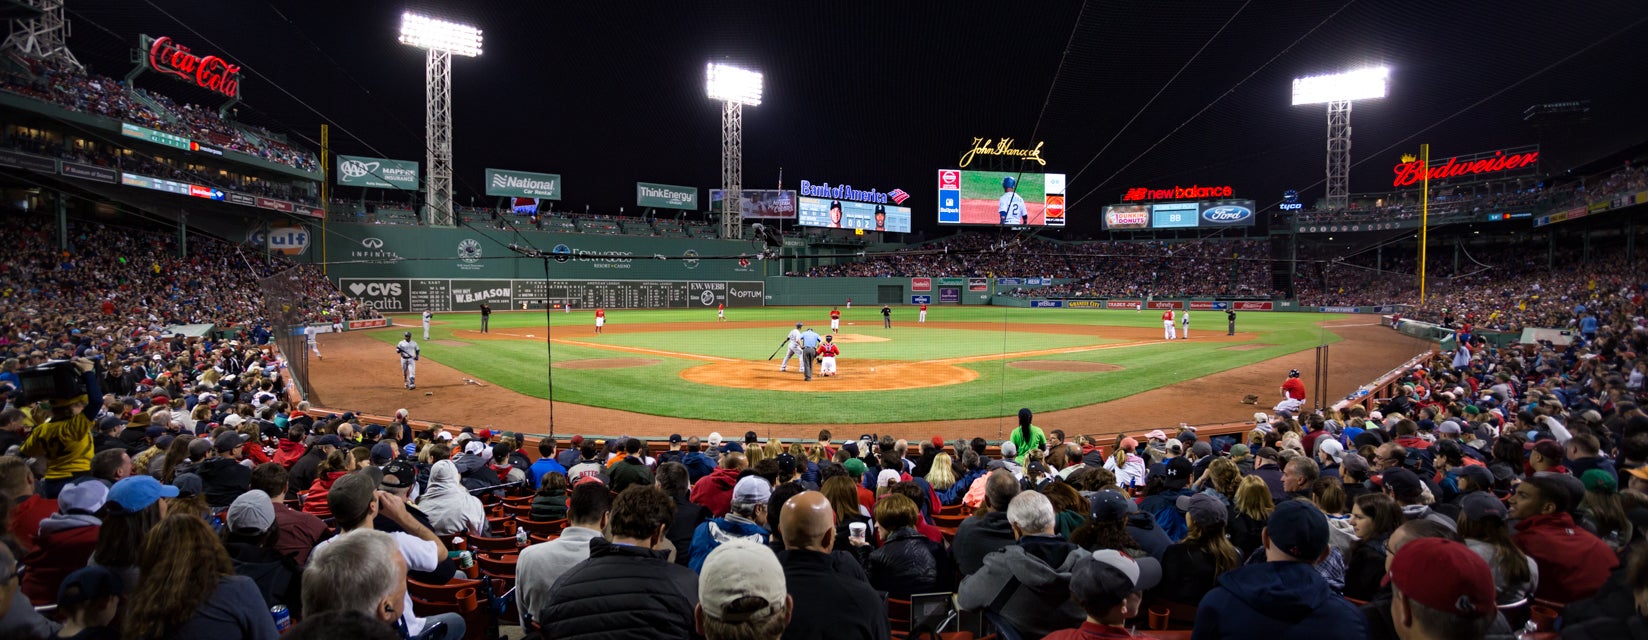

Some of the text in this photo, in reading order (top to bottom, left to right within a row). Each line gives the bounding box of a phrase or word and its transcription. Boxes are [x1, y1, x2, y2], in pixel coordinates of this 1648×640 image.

[150, 36, 240, 97] Coca-Cola
[959, 137, 1047, 168] John Hancock
[343, 160, 368, 177] AAA
[1393, 150, 1539, 187] Budweiser
[507, 176, 554, 190] National
[640, 186, 693, 202] ThinkEnergy
[800, 179, 888, 204] Bank of America
[1148, 190, 1175, 199] new
[1175, 185, 1233, 199] balance
[1012, 204, 1019, 216] 2
[1211, 208, 1242, 220] Ford
[366, 282, 403, 296] CVS
[737, 290, 762, 298] OPTUM
[579, 470, 599, 478] BETTS
